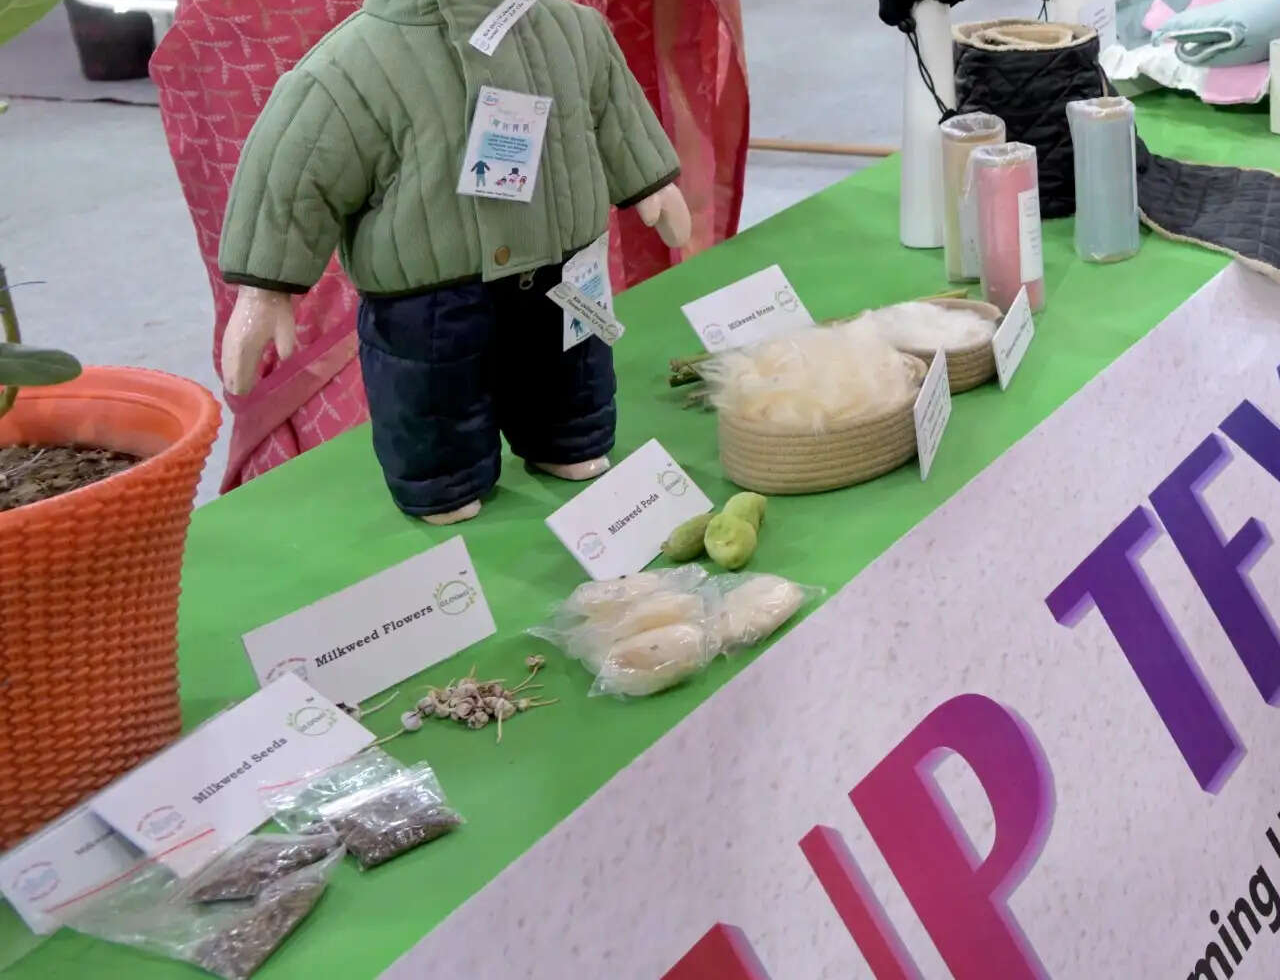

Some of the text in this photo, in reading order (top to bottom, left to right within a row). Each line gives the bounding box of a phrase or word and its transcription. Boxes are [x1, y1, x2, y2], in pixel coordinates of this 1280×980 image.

[608, 492, 660, 535] Milkweed Pods
[315, 604, 434, 668] Milkweed Flowers
[191, 736, 288, 805] Milkweed Seeds
